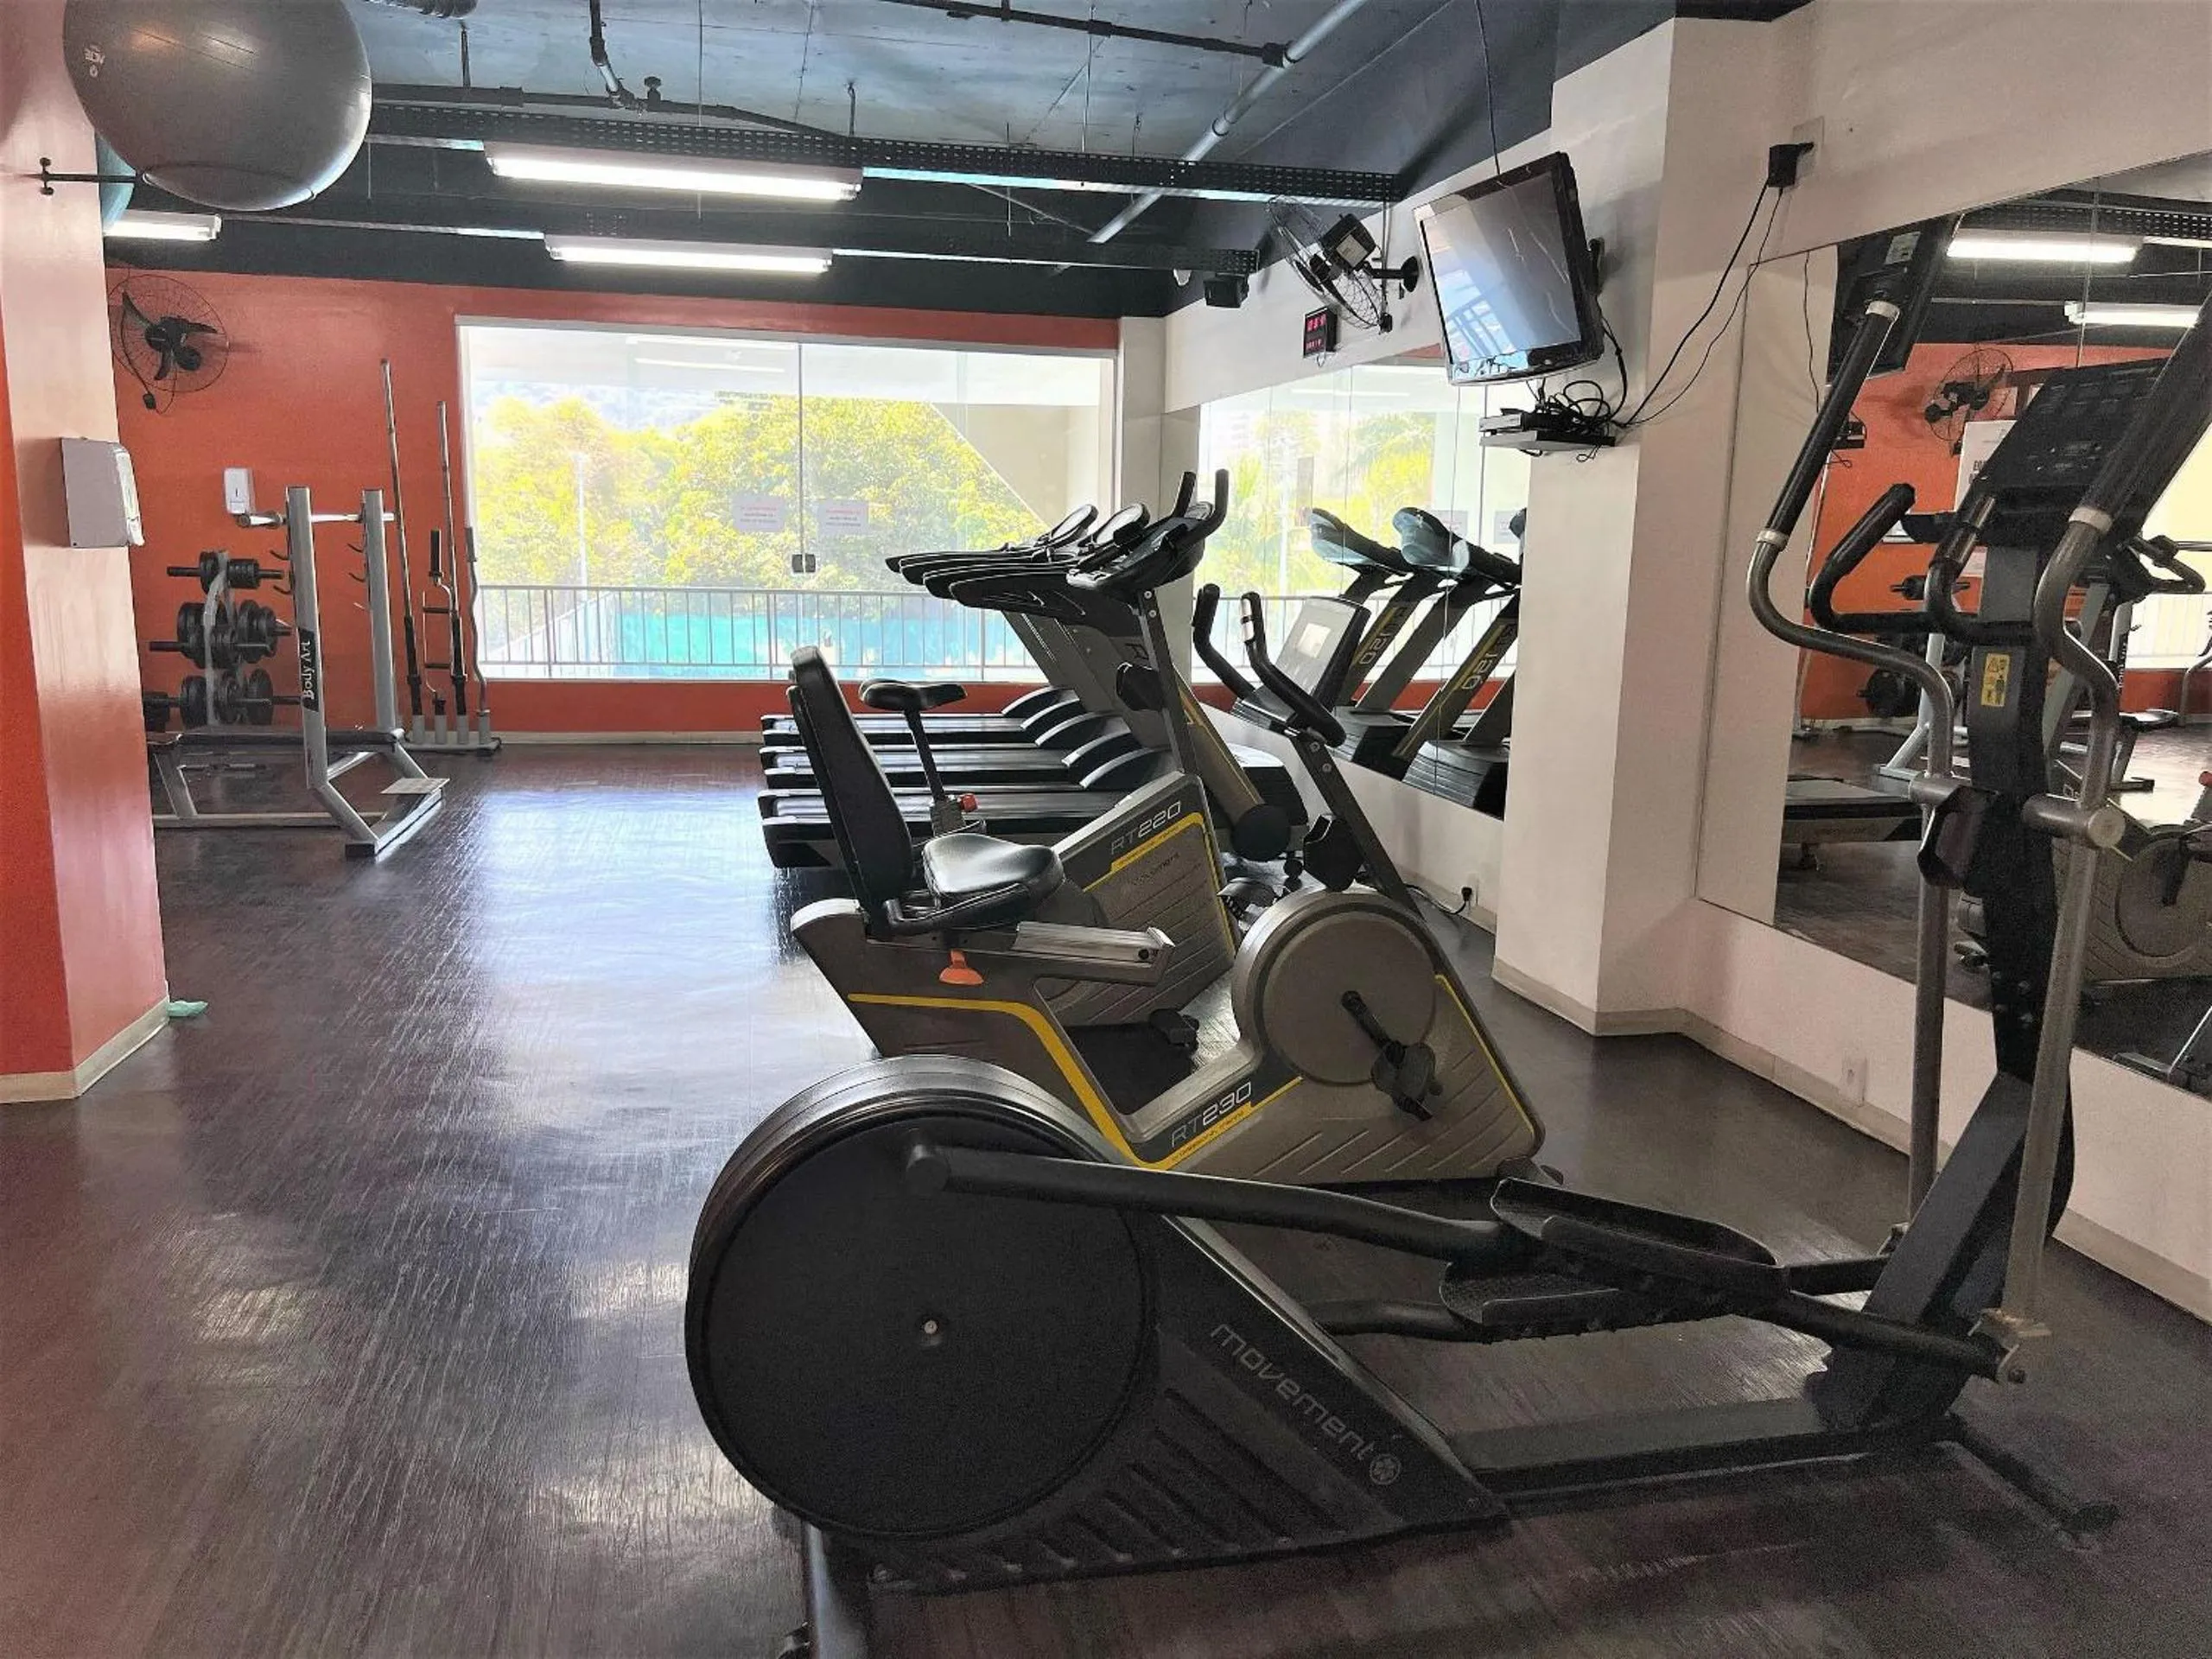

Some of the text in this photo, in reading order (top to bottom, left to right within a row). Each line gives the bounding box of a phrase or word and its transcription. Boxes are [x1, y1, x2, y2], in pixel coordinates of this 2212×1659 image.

[300, 640, 315, 700] Body Art
[1110, 800, 1181, 855] RT220
[1172, 1081, 1252, 1148] RT230
[1211, 1323, 1376, 1461] movement
